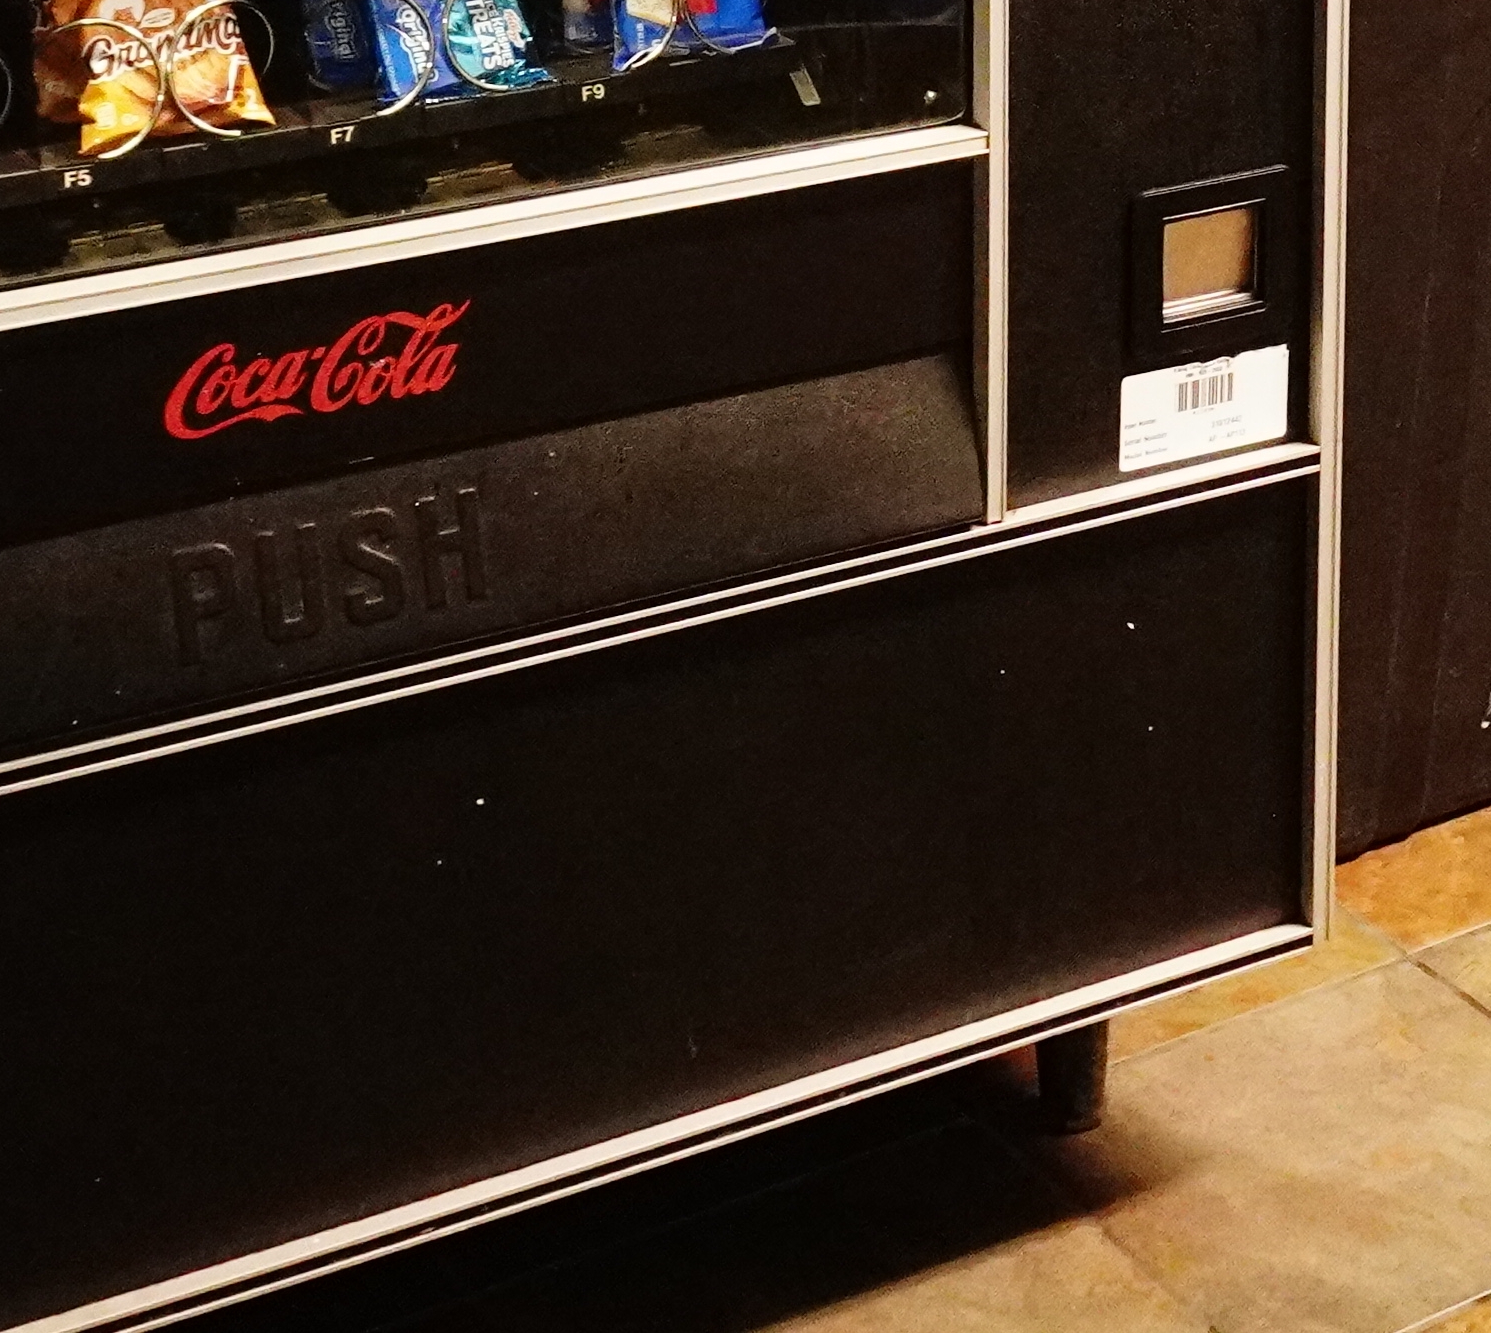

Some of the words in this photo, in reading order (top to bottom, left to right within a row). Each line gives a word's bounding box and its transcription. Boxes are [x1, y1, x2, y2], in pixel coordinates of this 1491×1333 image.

[581, 84, 606, 103] F9
[330, 125, 356, 145] F7
[63, 170, 93, 189] F5
[163, 298, 472, 440] Coca-Cola
[169, 485, 493, 669] PUSH
